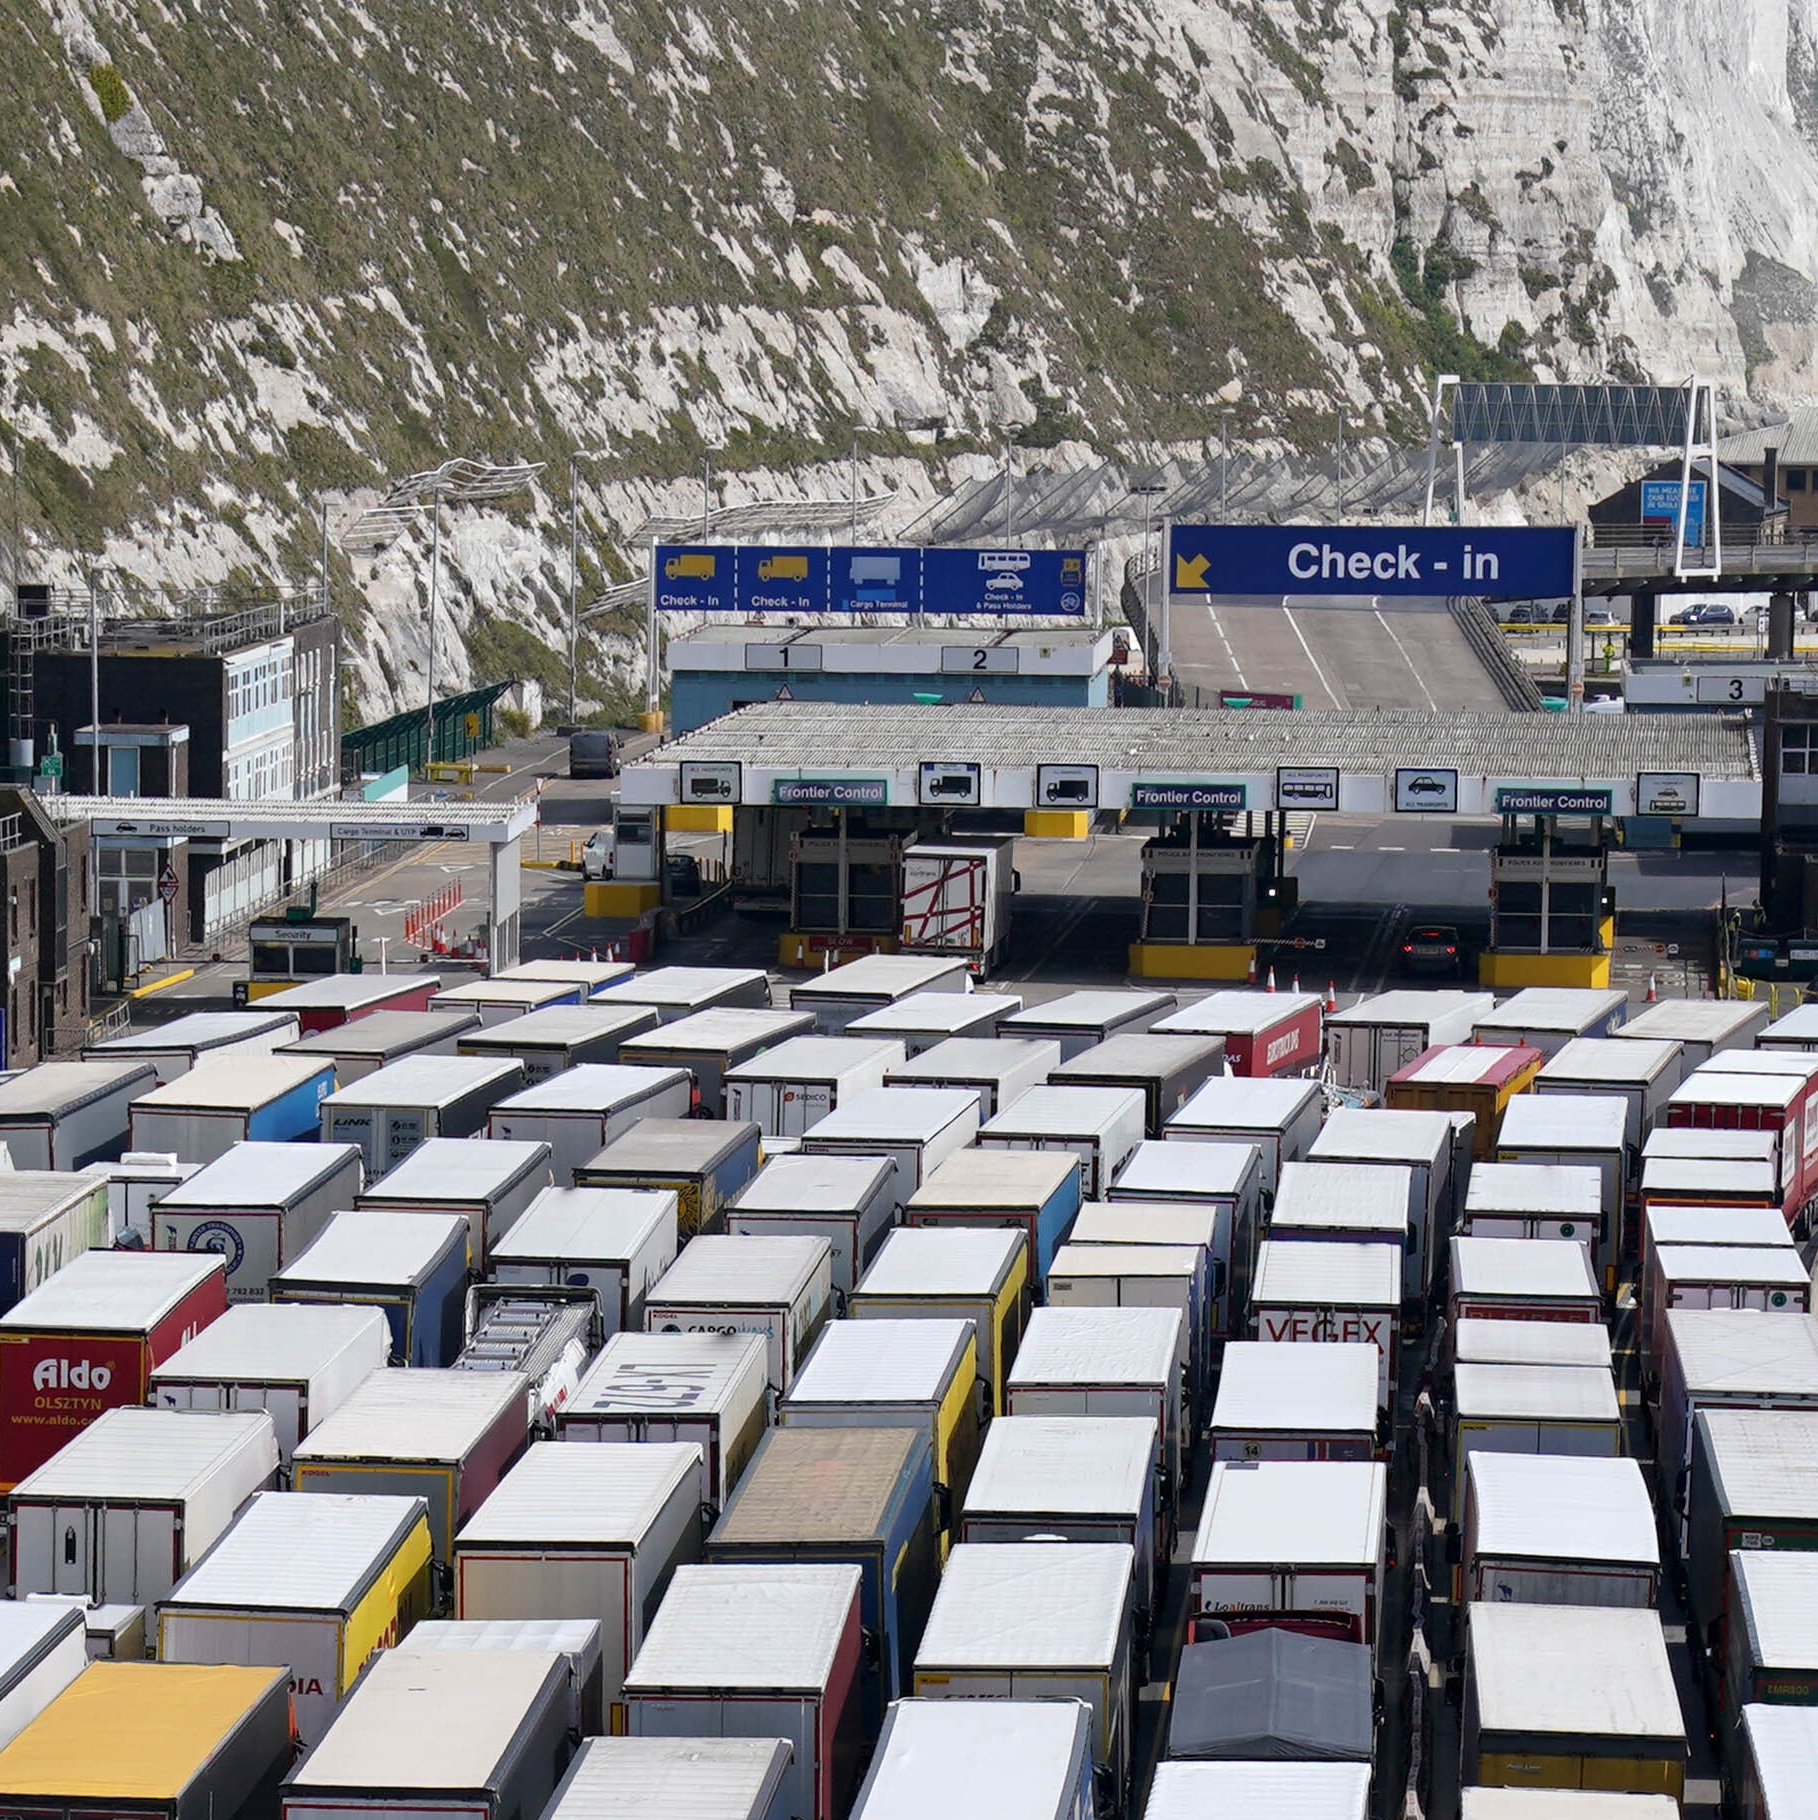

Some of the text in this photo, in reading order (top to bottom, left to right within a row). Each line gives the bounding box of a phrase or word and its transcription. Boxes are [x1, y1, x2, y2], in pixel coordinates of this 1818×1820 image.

[1288, 543, 1499, 580] Check in
[659, 594, 719, 607] Check In
[751, 595, 809, 607] Check In
[984, 592, 1009, 600] Check
[779, 647, 789, 667] 1
[973, 649, 987, 669] 2
[1729, 680, 1743, 700] 3
[779, 786, 882, 799] Frontier Control
[1137, 790, 1241, 804] Frontier Control
[1502, 795, 1607, 809] Frontier Control
[150, 823, 205, 833] Pass holders
[337, 827, 359, 838] Cargo
[360, 826, 392, 836] Terminal
[275, 930, 311, 940] Security
[33, 1358, 111, 1391] Aldo
[34, 1396, 102, 1410] OLSZTYN
[11, 1415, 99, 1426] www.aldo.co
